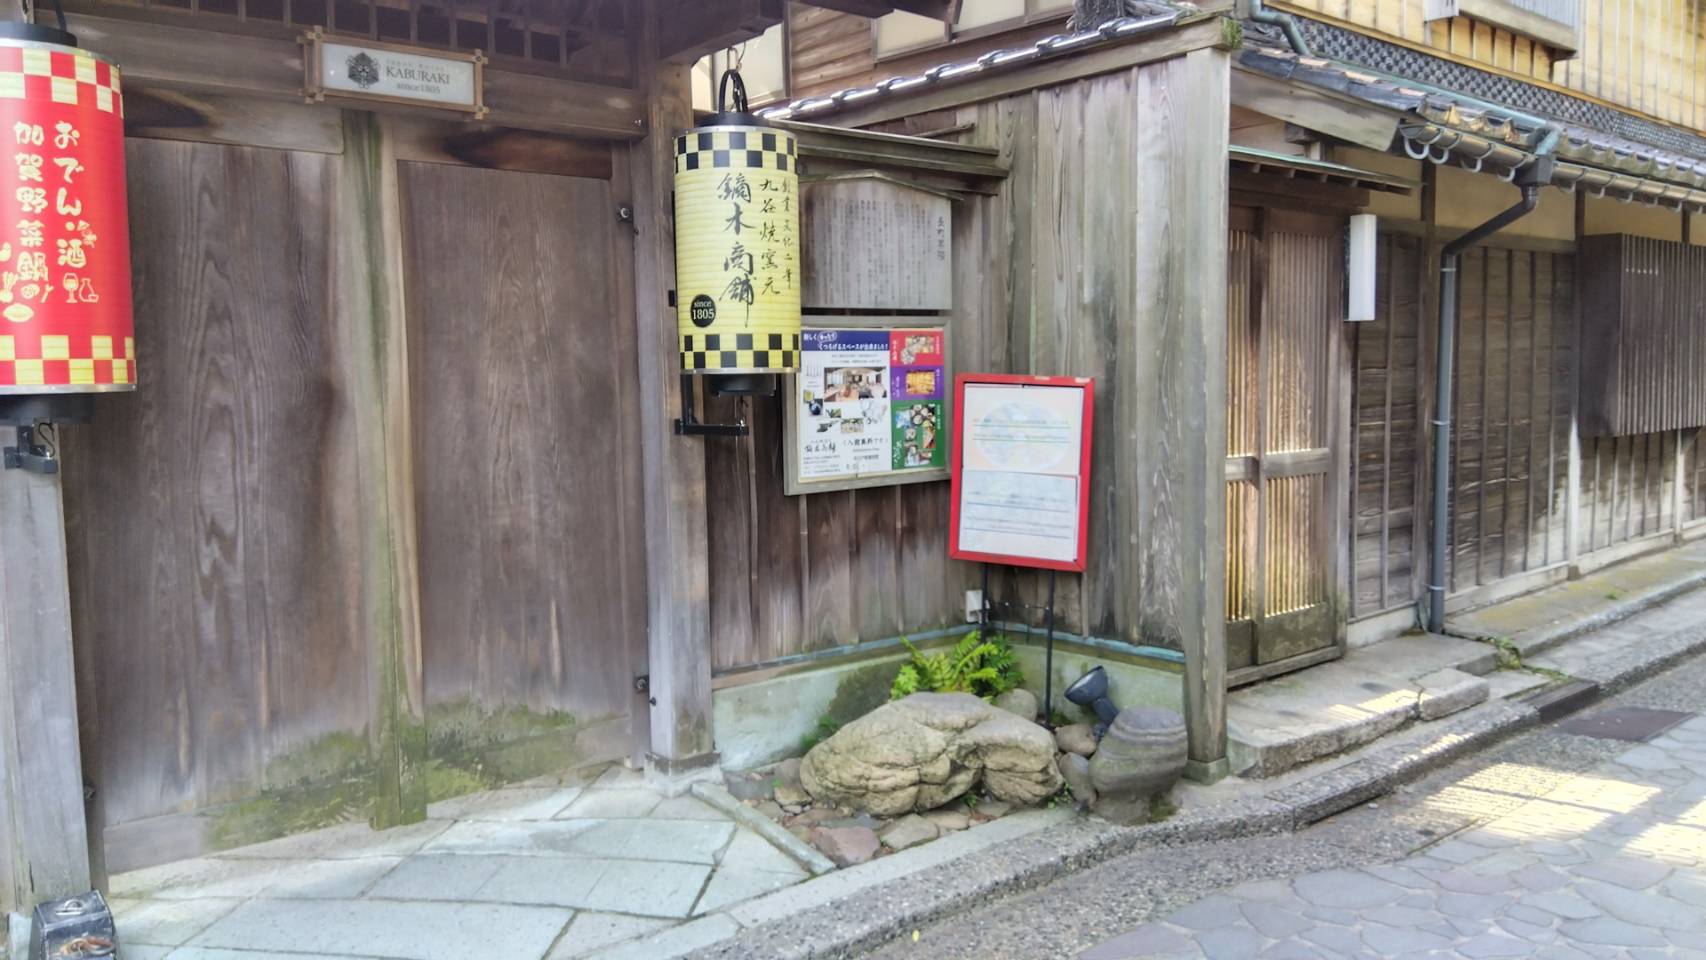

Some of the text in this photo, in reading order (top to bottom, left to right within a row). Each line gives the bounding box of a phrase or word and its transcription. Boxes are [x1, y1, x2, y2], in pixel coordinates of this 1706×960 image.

[386, 66, 451, 85] KABURAKI
[13, 121, 49, 281] 加賀野菜鍋
[53, 120, 87, 268] おでん・酒
[759, 178, 780, 295] 九谷焼窯元
[692, 308, 715, 320] 1805
